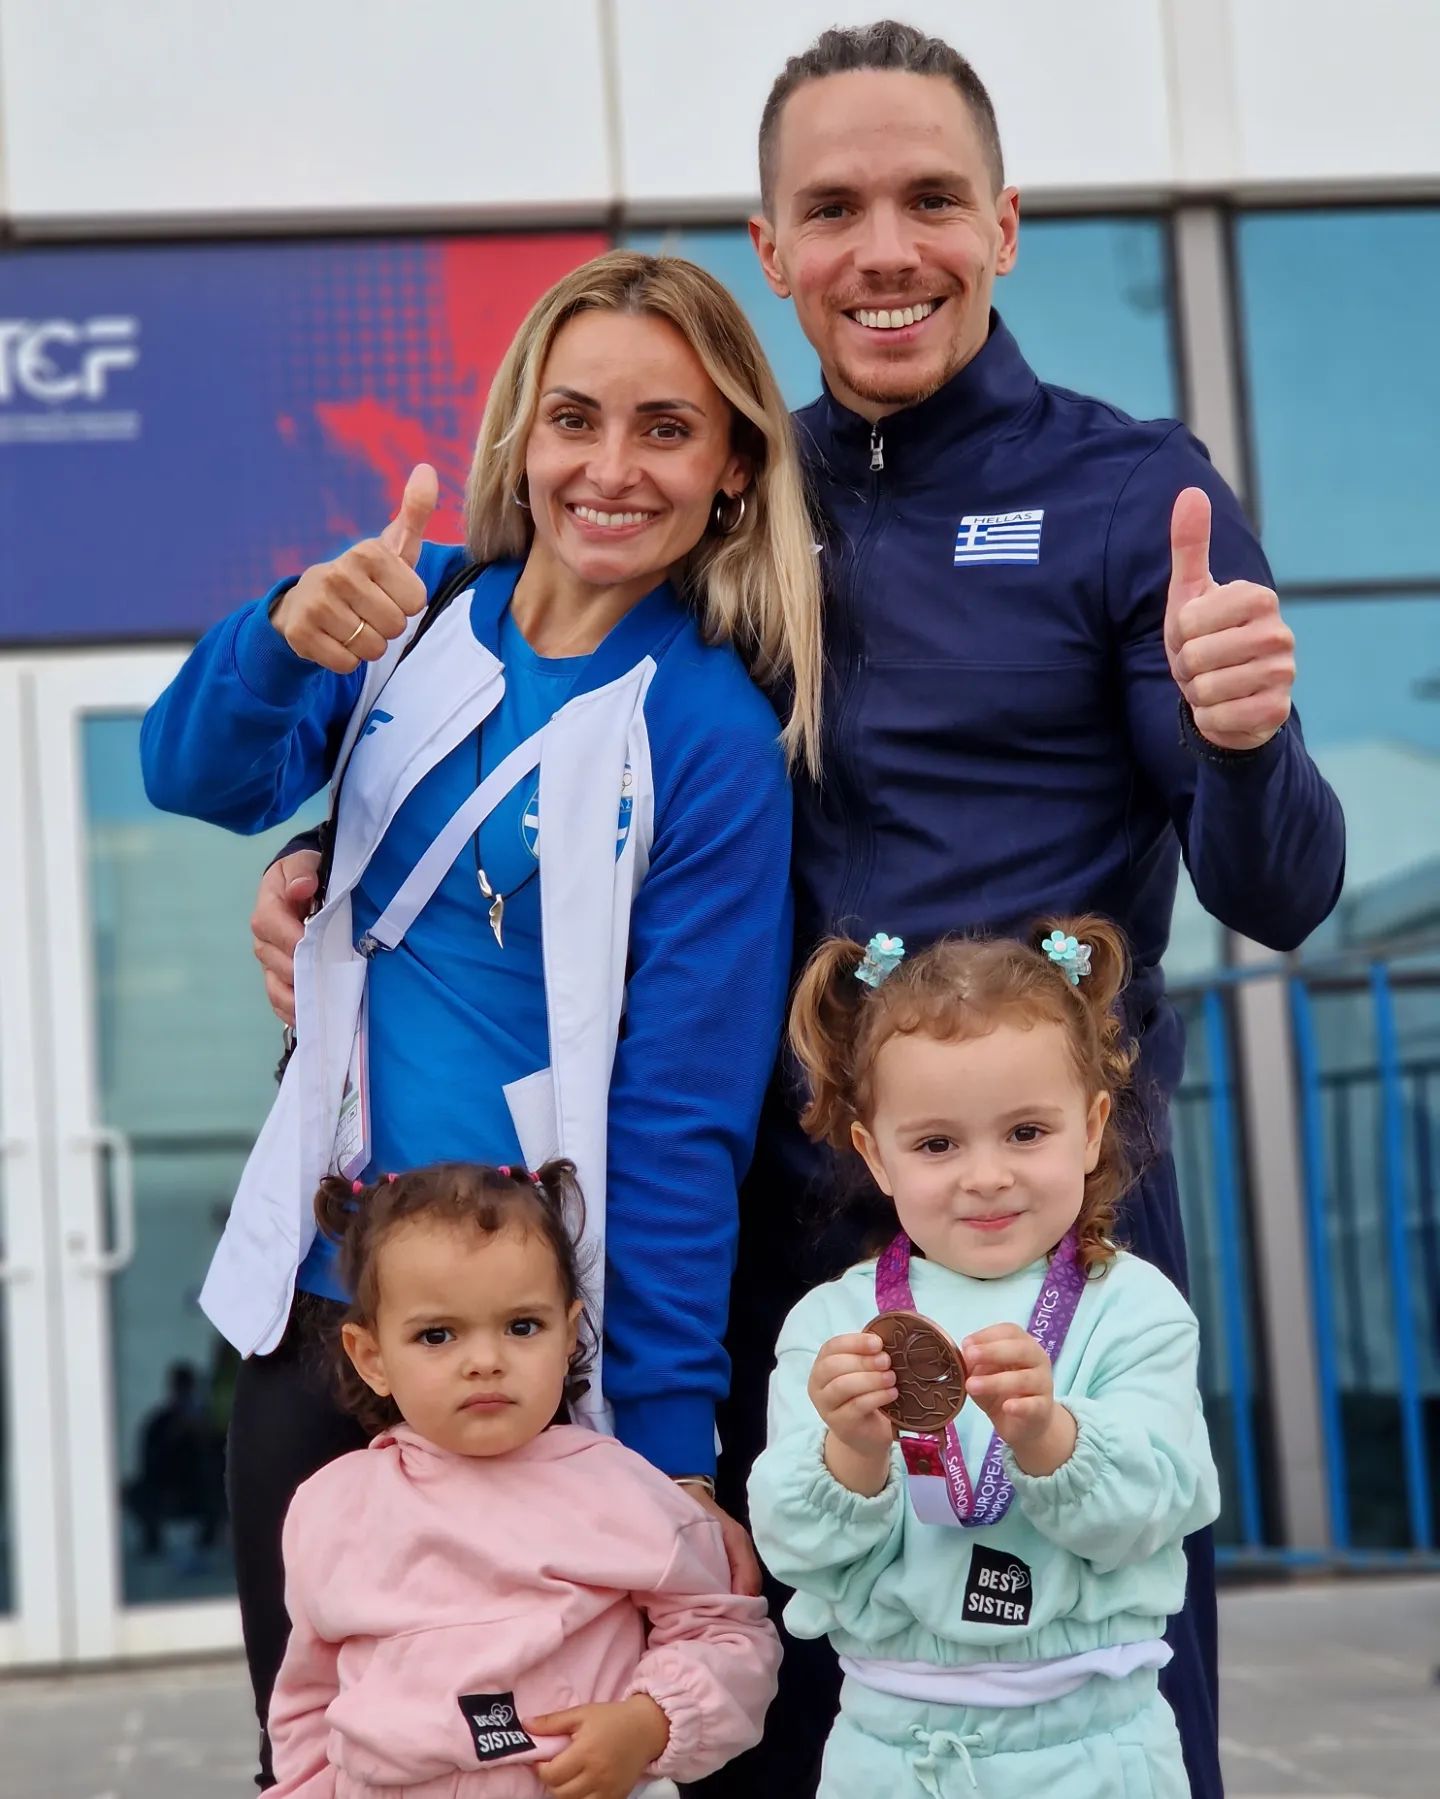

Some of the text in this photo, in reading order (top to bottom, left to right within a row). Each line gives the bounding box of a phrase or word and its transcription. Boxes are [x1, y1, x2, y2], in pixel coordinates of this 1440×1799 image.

[974, 512, 1033, 524] HELLAS
[978, 1567, 1019, 1594] BEST
[968, 1592, 1025, 1620] SISTER
[472, 1714, 507, 1728] BEST
[478, 1731, 529, 1753] SISTER
